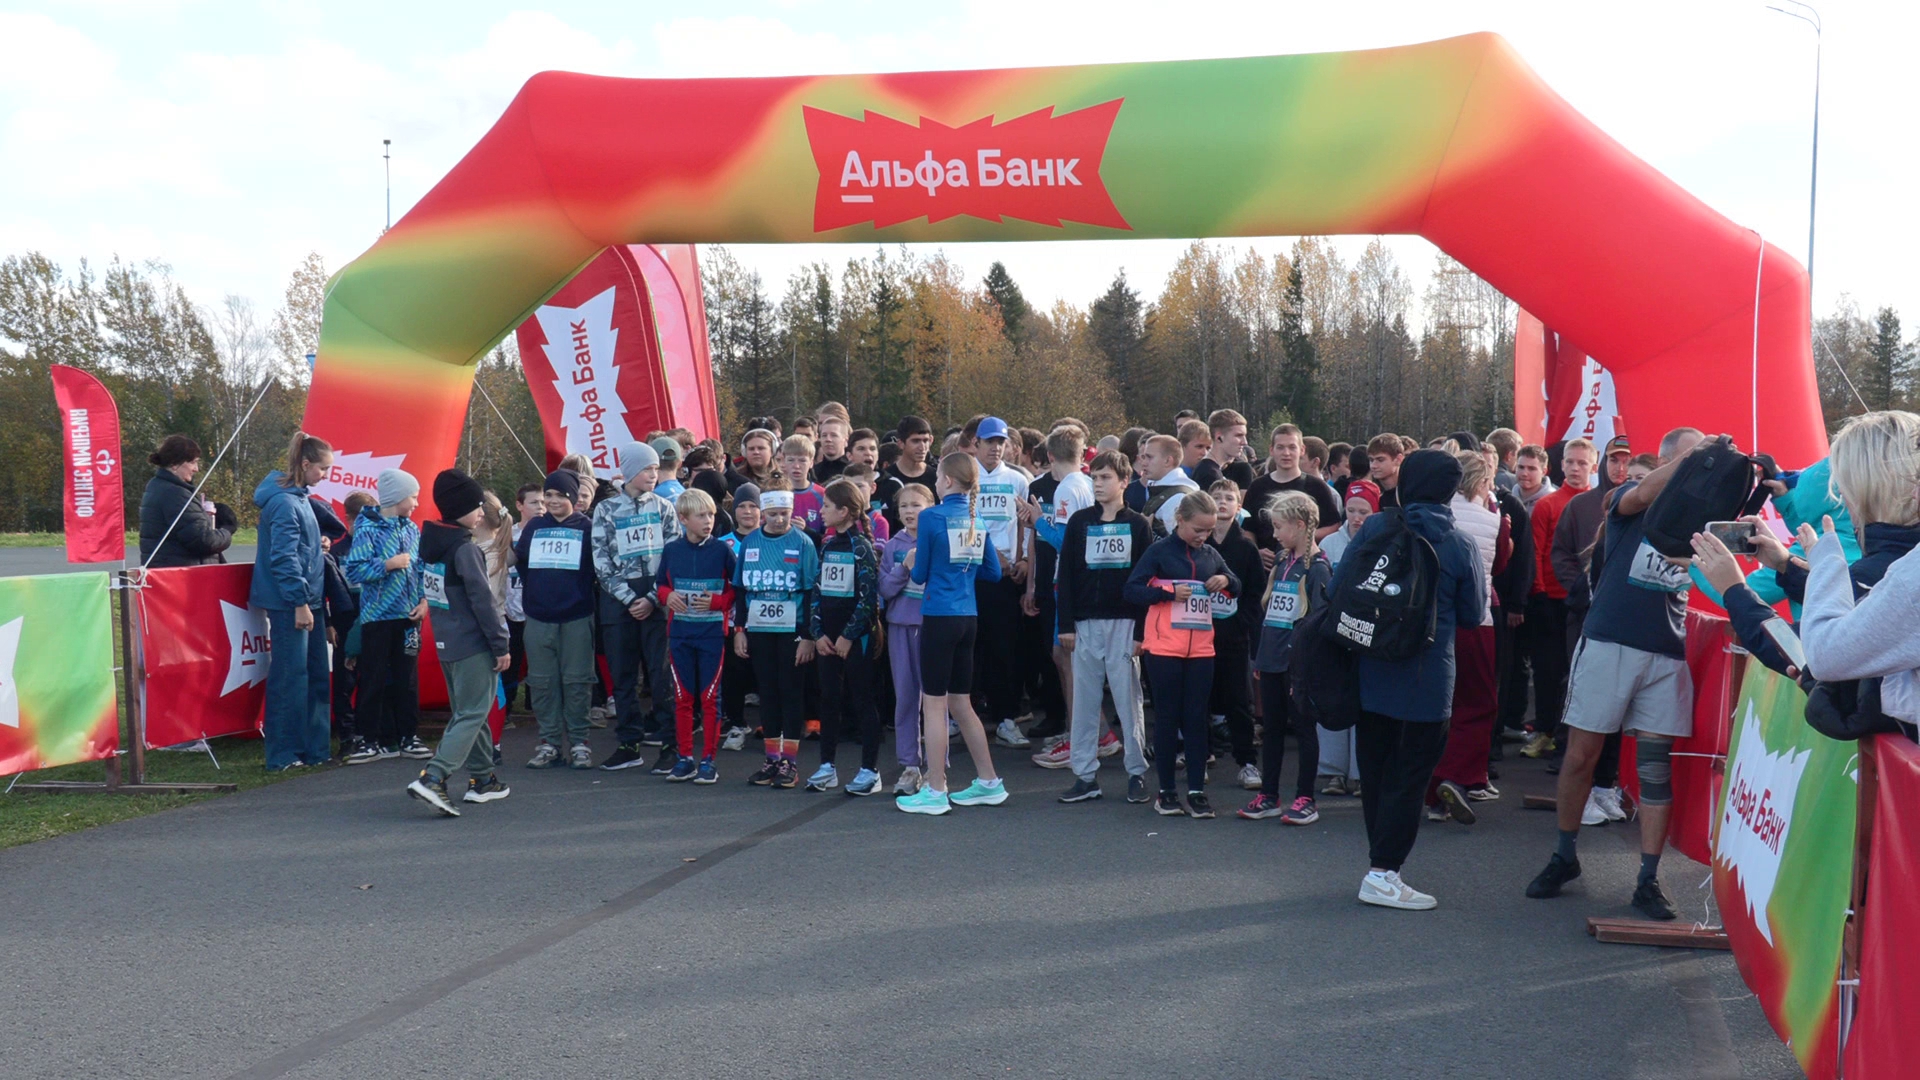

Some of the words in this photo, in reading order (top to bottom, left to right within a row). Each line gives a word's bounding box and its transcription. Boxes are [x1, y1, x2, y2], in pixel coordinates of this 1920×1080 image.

[840, 150, 970, 198] Альфа
[977, 149, 1083, 187] Банк
[570, 318, 594, 385] Банк
[580, 387, 611, 470] Альфа
[329, 465, 378, 490] Банк
[980, 495, 1007, 508] 1179
[540, 541, 570, 554] 1181
[1095, 538, 1125, 553] 1768
[743, 569, 797, 588] КРОСС
[759, 603, 784, 618] 266
[1184, 598, 1209, 614] 1906
[1752, 788, 1786, 856] Банк
